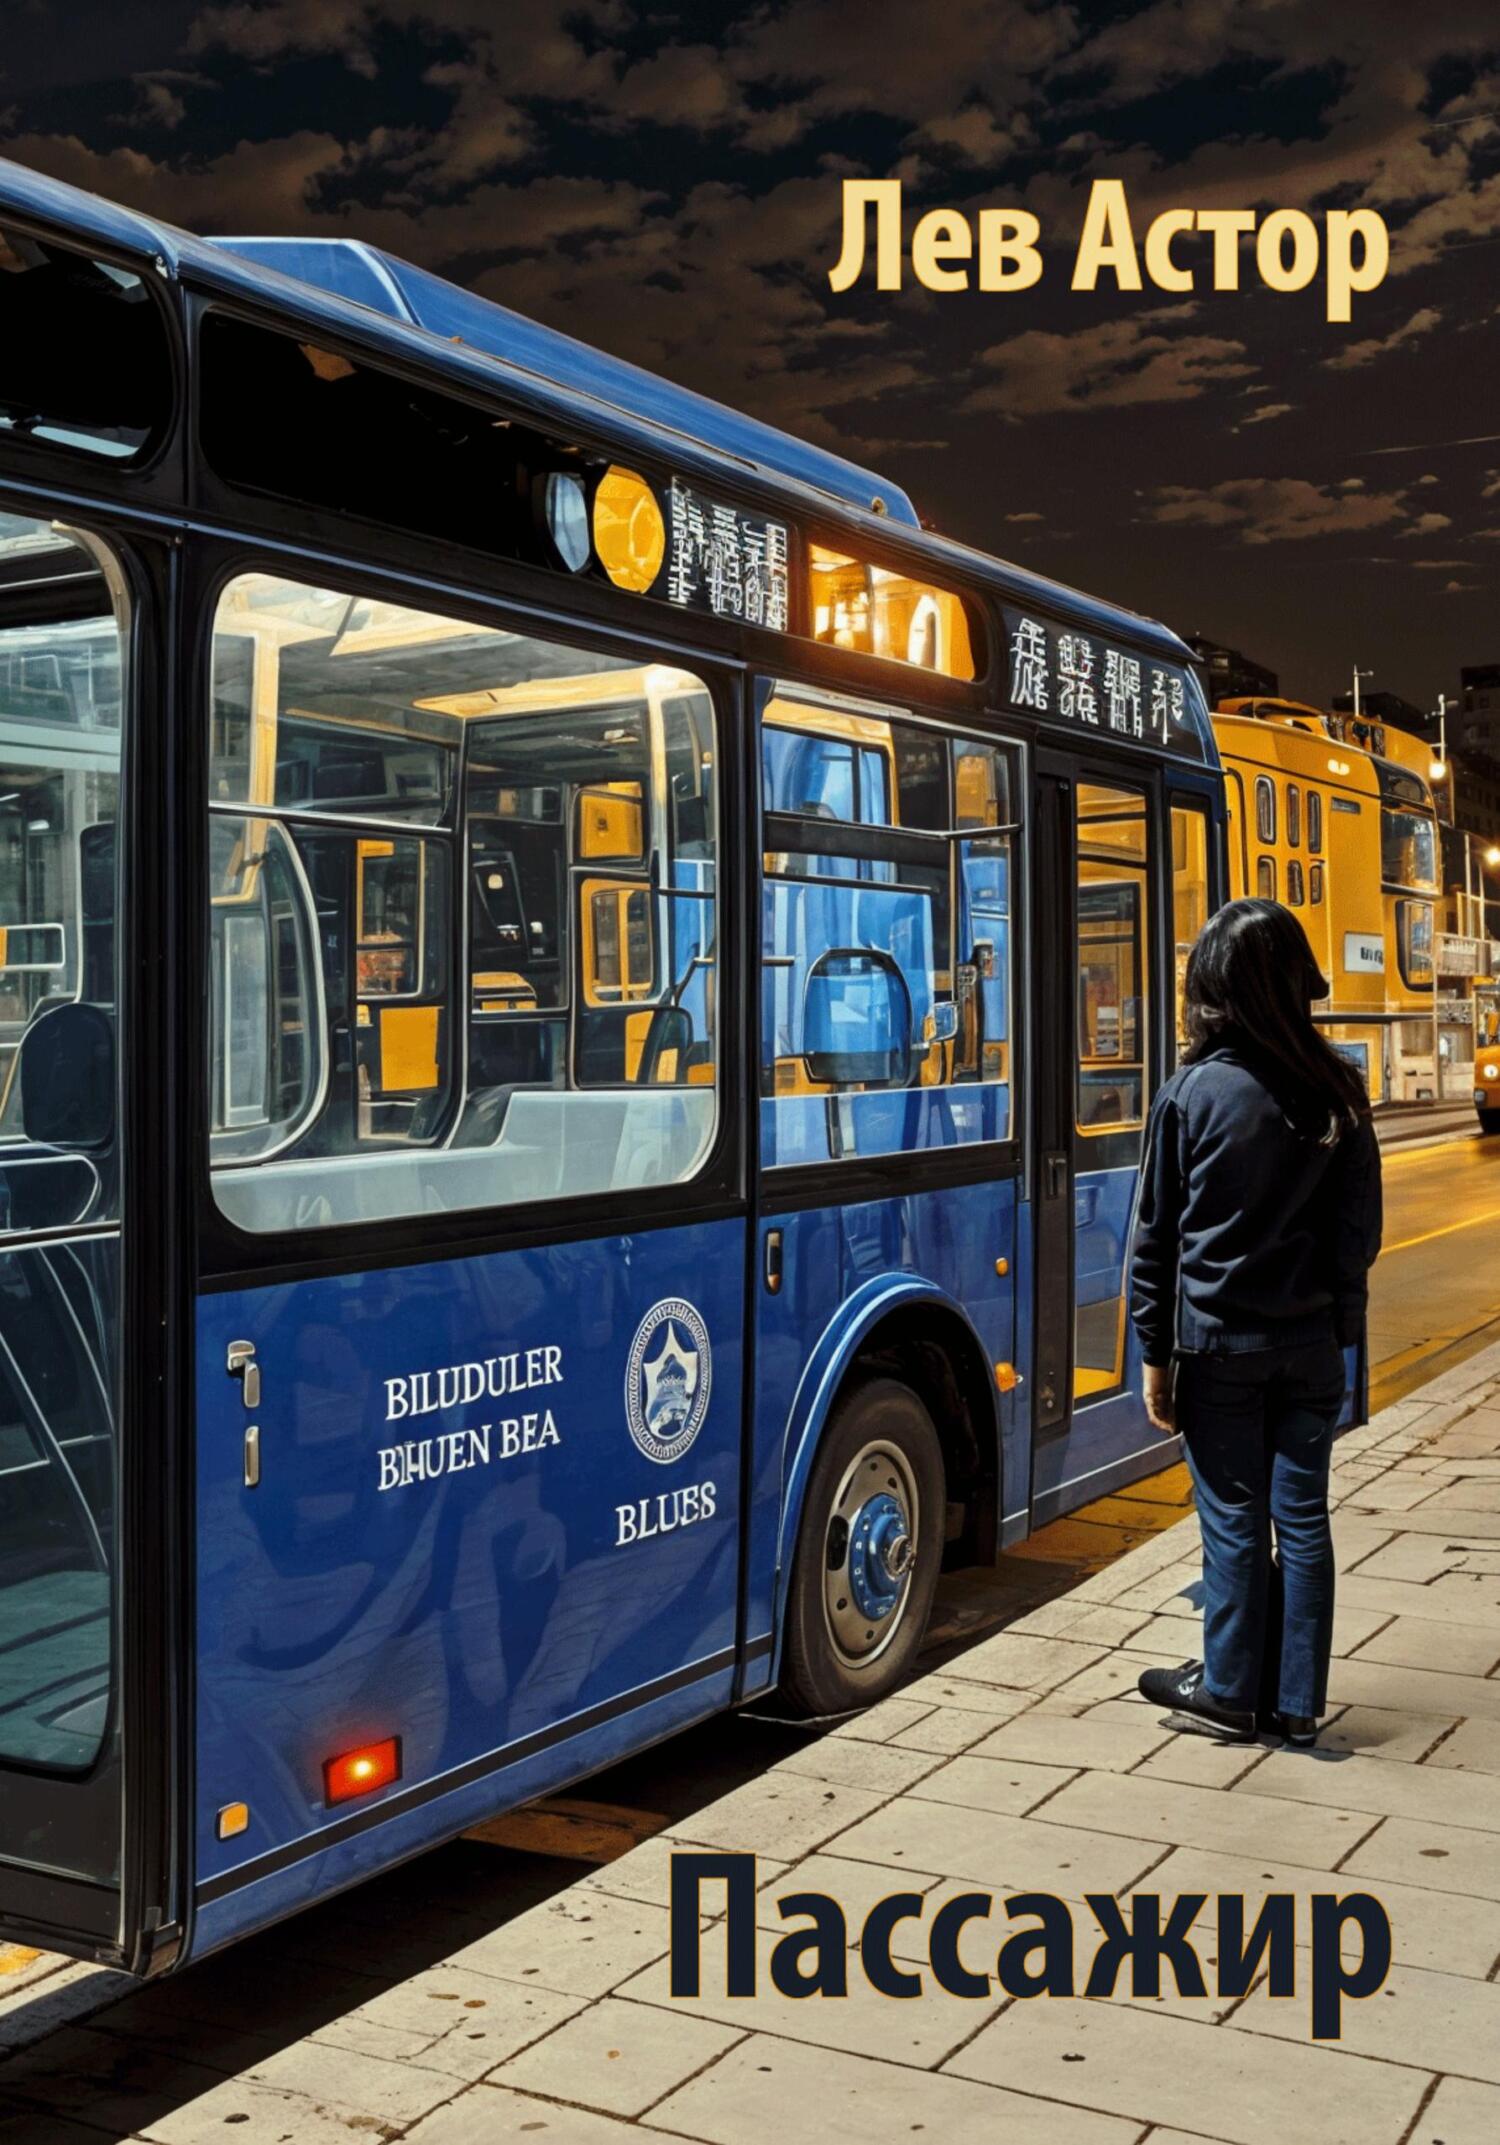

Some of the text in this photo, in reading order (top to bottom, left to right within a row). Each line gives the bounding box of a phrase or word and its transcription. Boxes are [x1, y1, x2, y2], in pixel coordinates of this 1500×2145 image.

[383, 1345, 564, 1421] BILUDULER
[499, 1409, 561, 1459] BEA
[615, 1481, 717, 1546] BLUES
